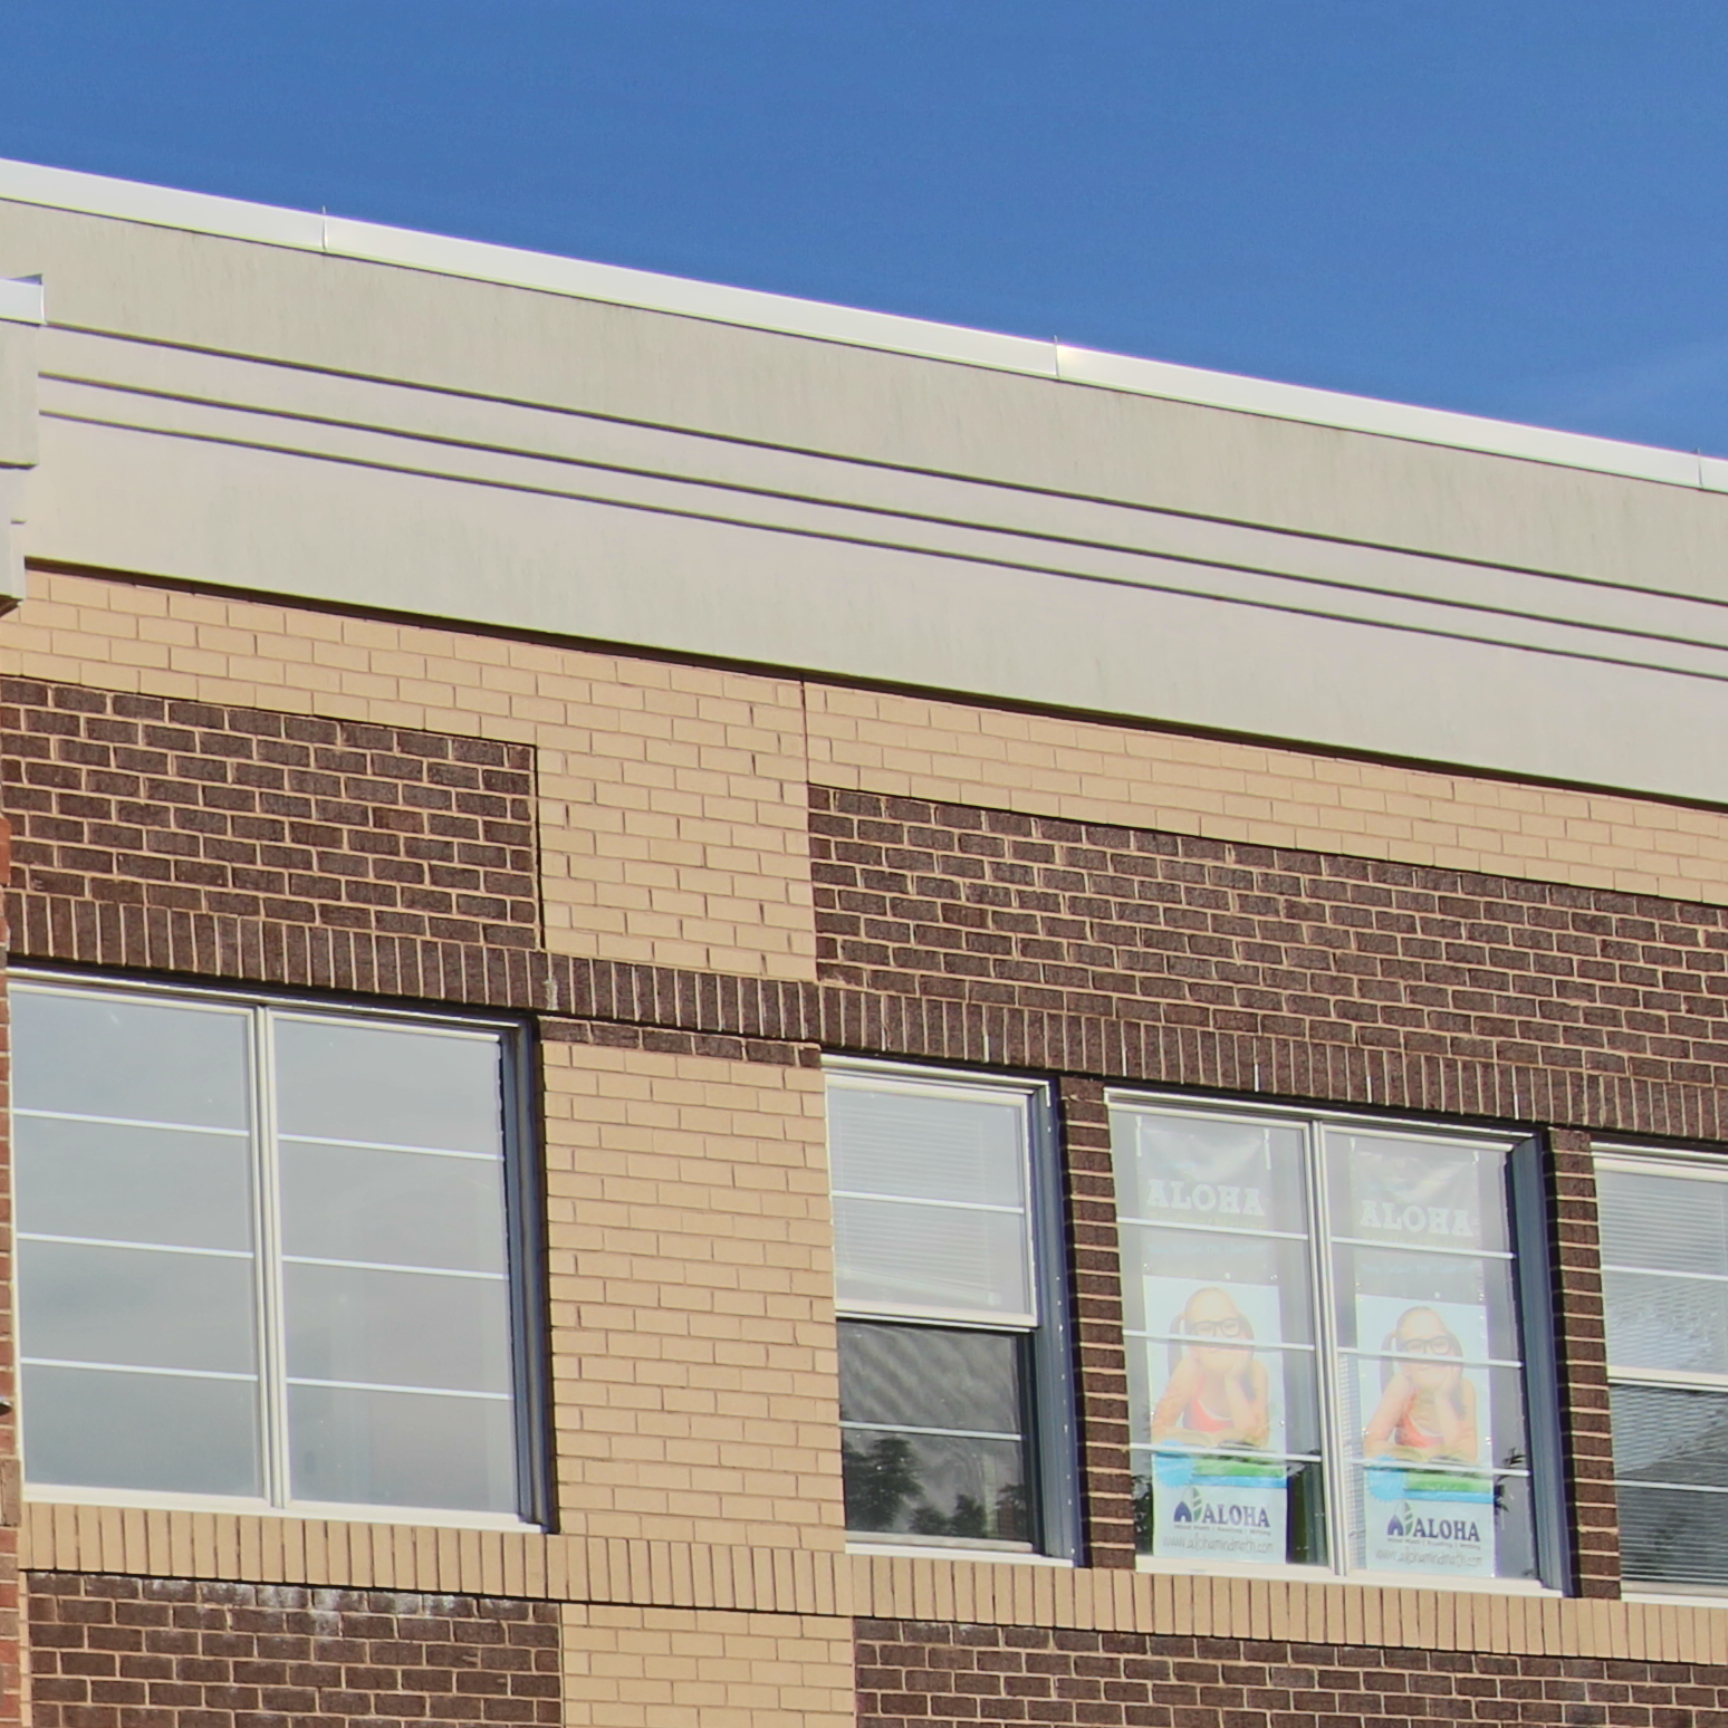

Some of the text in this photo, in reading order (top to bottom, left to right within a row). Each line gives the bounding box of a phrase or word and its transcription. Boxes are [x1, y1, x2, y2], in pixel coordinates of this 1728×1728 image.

[1147, 1179, 1265, 1217] ALOHA
[1360, 1200, 1474, 1238] ALOHA
[1202, 1503, 1270, 1528] ALOHA
[1413, 1518, 1481, 1542] ALOHA
